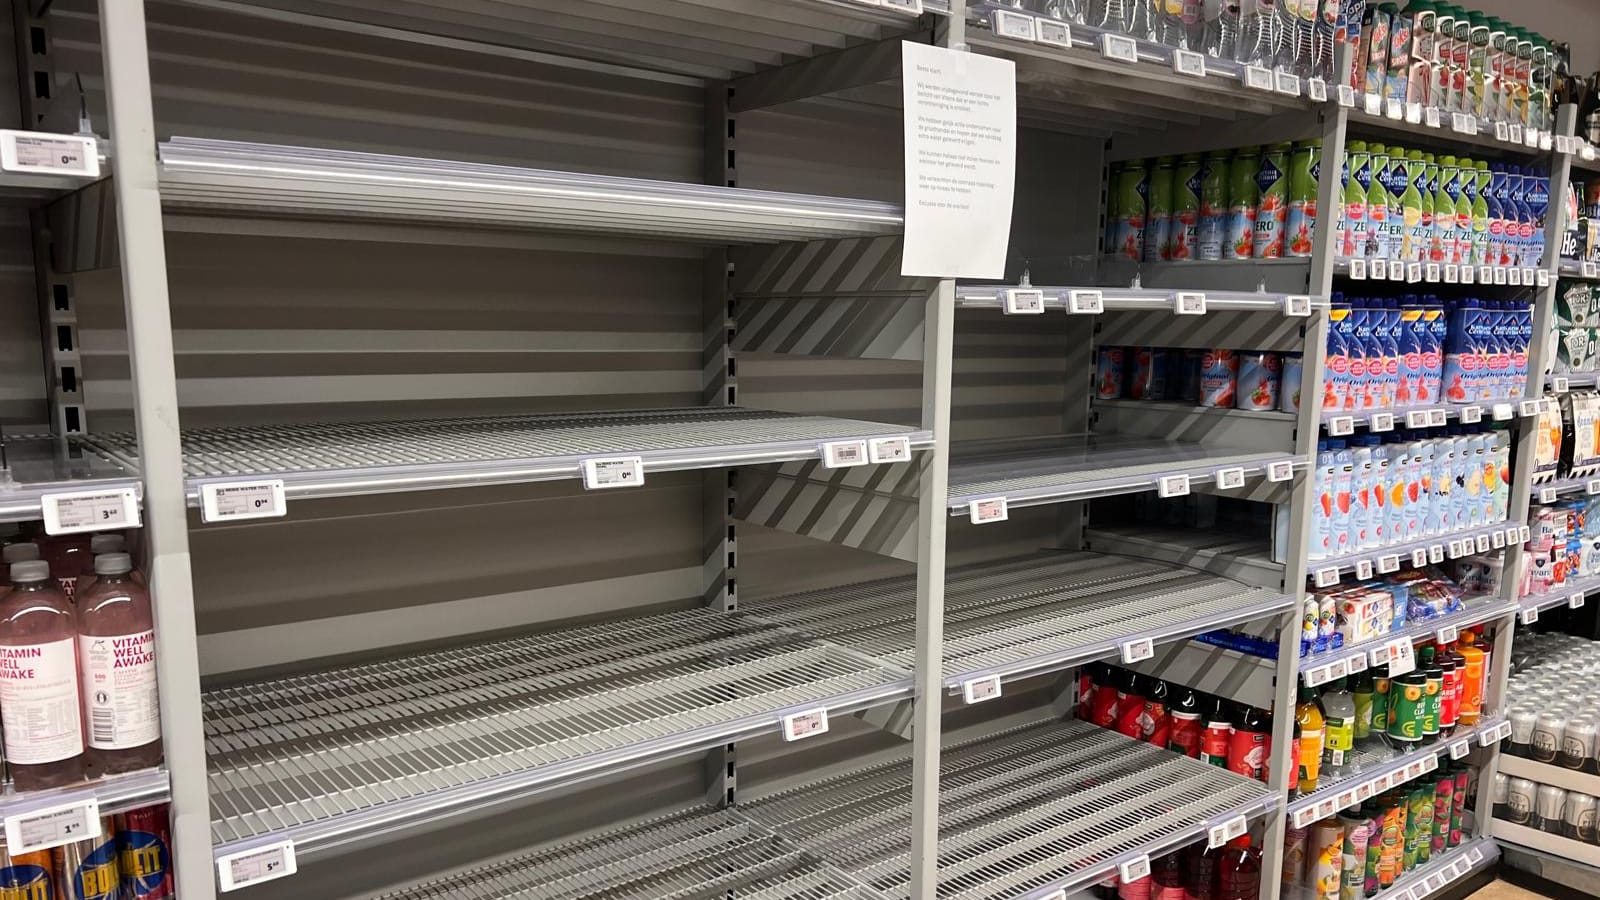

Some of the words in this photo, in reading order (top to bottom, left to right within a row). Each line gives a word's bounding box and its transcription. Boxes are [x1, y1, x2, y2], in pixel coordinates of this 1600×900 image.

[0, 647, 41, 659] ITAMIN
[113, 645, 144, 658] WELL
[114, 651, 154, 668] AWAKE
